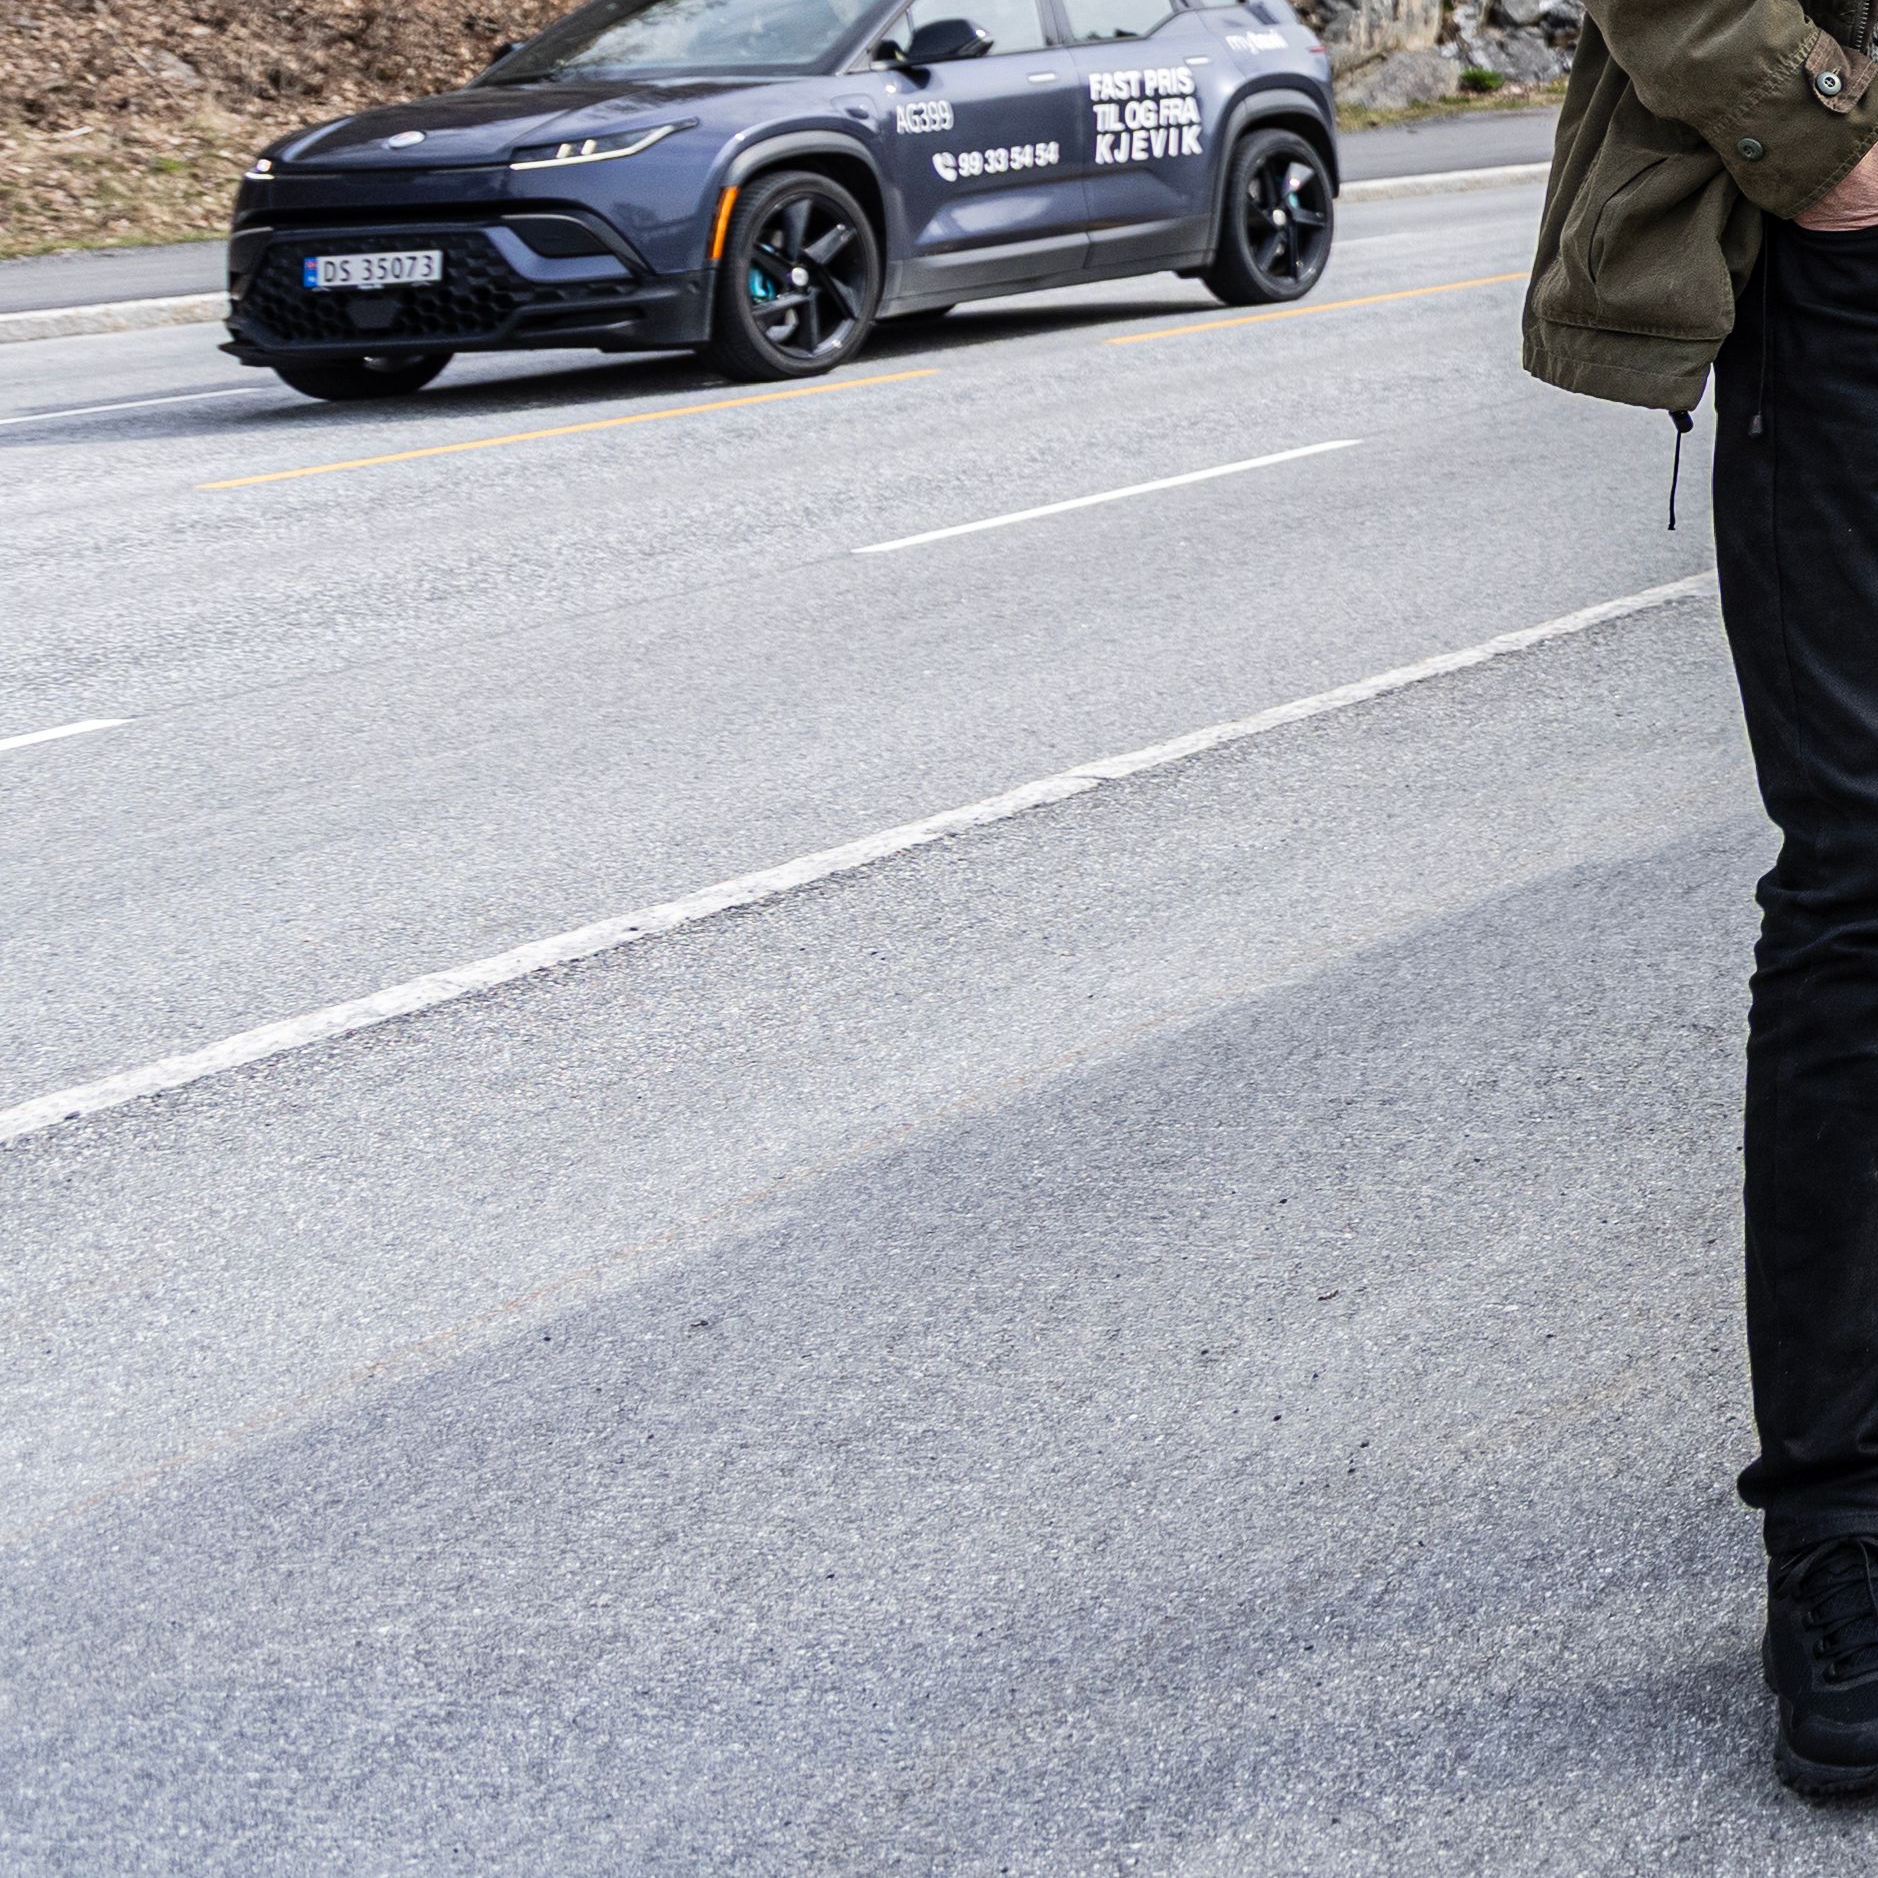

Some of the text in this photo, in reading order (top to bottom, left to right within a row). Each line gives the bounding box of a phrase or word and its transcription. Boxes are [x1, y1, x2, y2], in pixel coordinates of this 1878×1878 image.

[1088, 66, 1195, 102] FAST PRIS
[896, 100, 955, 134] AG399
[1093, 96, 1201, 132] TIL OG FRA
[958, 141, 1060, 177] 99 33 54 54
[1095, 125, 1203, 165] KJEVIK
[323, 255, 434, 283] DS 35073
